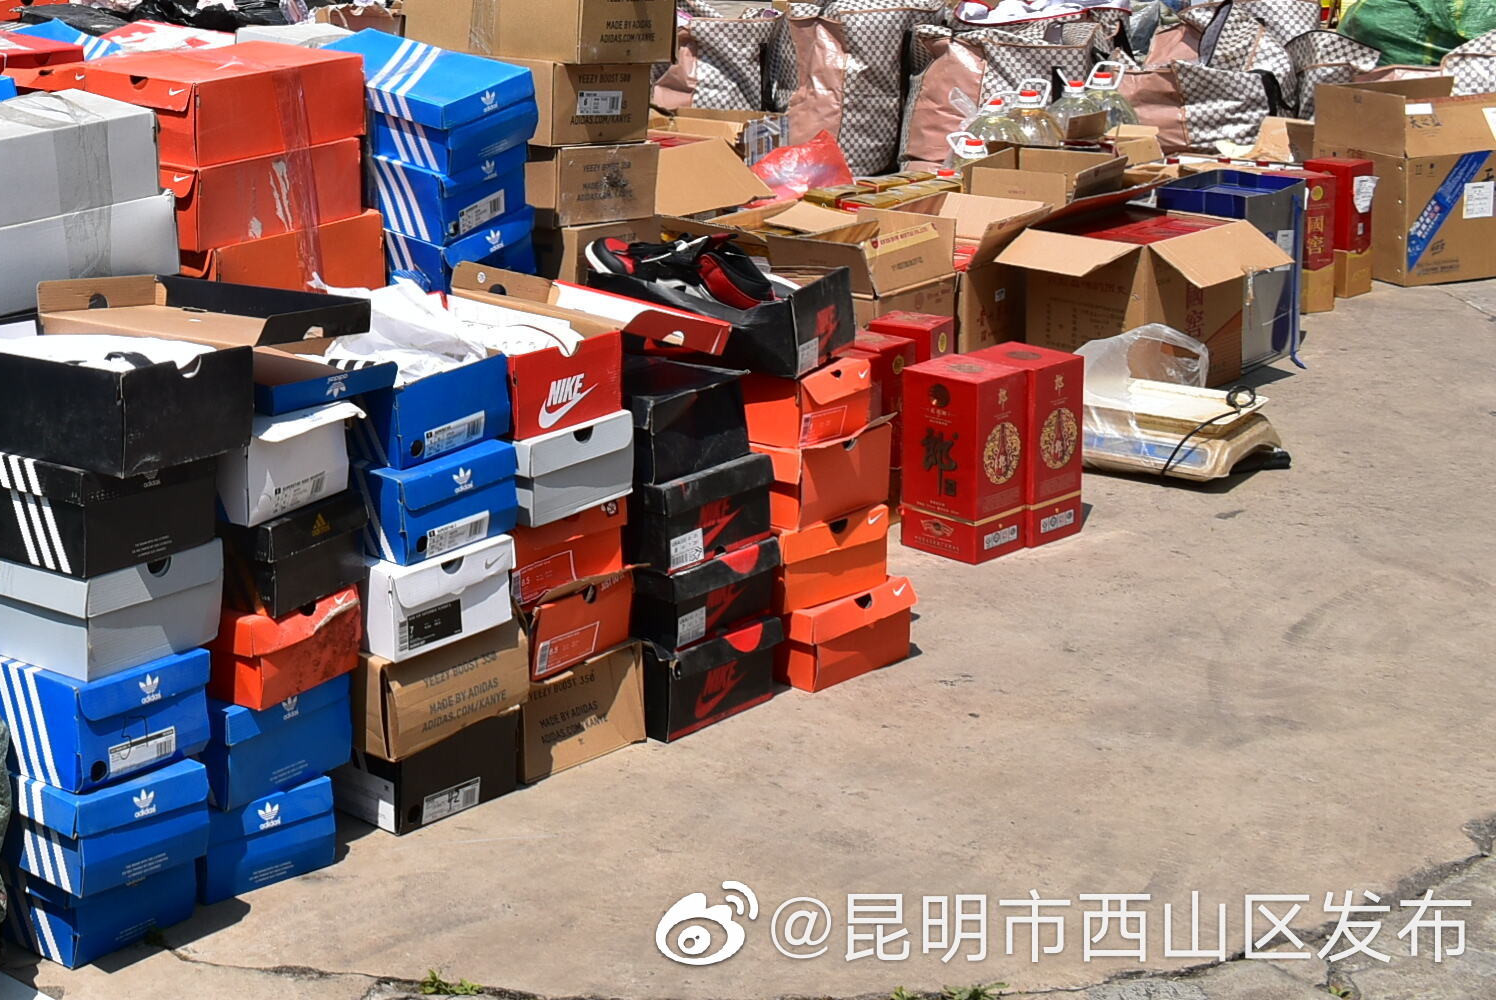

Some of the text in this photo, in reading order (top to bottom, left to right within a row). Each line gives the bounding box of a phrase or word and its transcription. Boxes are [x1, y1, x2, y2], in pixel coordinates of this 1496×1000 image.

[606, 19, 652, 30] MADE BY ADIDAS
[546, 372, 585, 408] NIKE
[423, 671, 451, 688] YEEZY
[453, 659, 480, 677] BOOST
[429, 677, 499, 714] MADE BY ADIDAS
[554, 678, 577, 693] BOOST
[141, 691, 162, 705] adidas
[421, 689, 508, 733] ADIDAS.COM/KANYE
[539, 700, 599, 729] MADE BY ADIDAS
[134, 802, 157, 819] adidas
[259, 816, 282, 831] adidas
